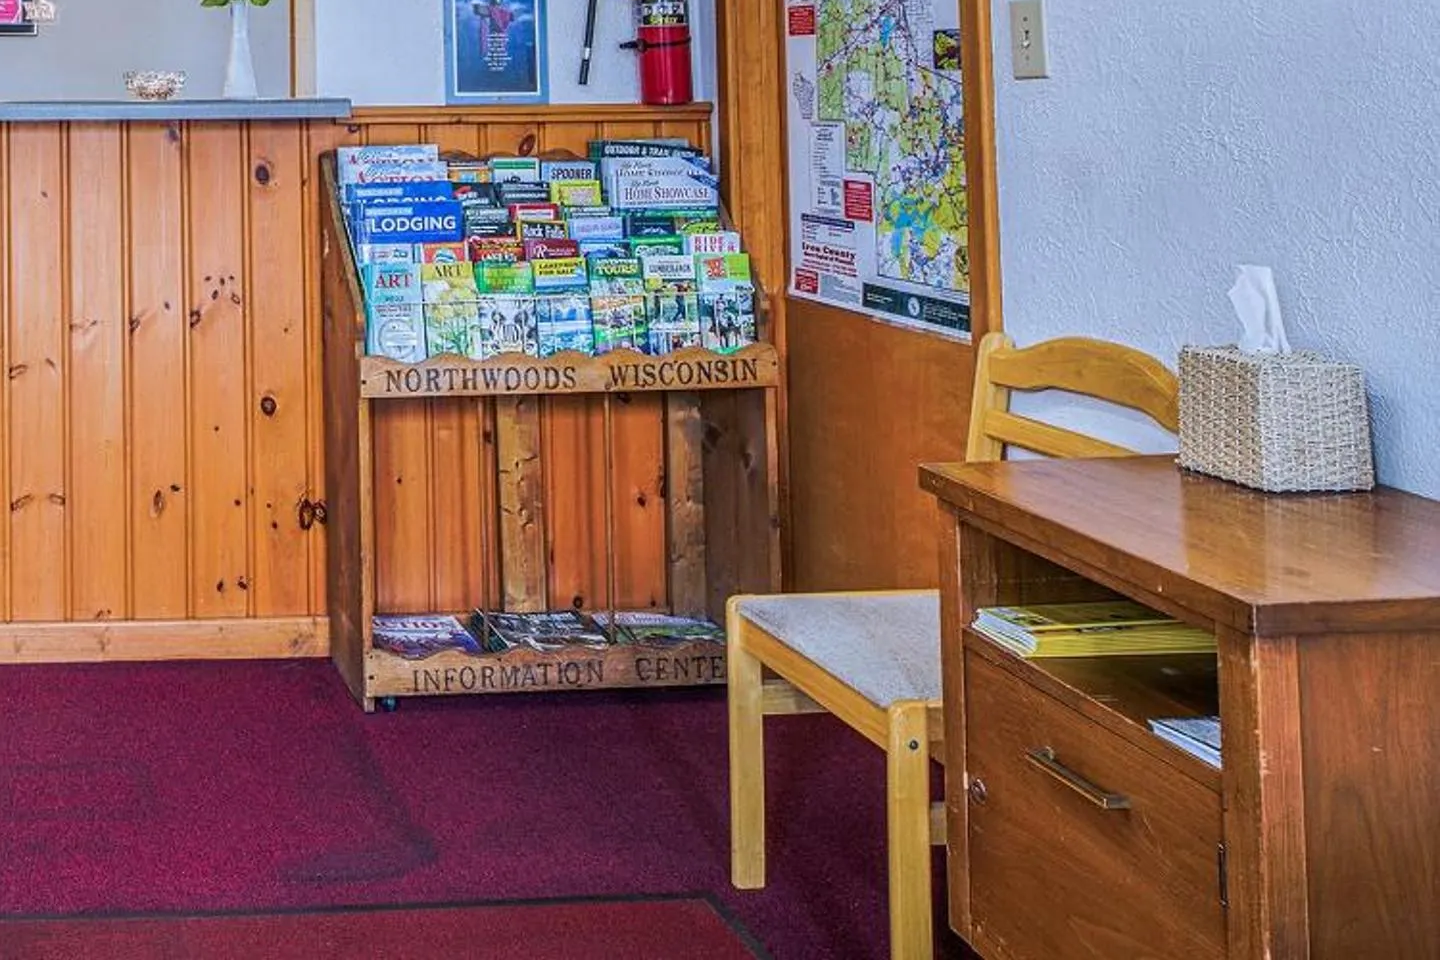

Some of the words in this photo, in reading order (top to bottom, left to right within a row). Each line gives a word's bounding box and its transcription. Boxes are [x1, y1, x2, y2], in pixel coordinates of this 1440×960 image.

[551, 169, 592, 179] SPOONER
[371, 216, 456, 233] LODGING
[823, 245, 857, 261] County
[435, 264, 464, 277] ART
[375, 273, 413, 289] ART
[385, 367, 576, 393] NORTHWOODS
[605, 360, 758, 390] WISCONSIN
[412, 660, 604, 692] INFORMATION
[635, 656, 726, 681] CENTE
